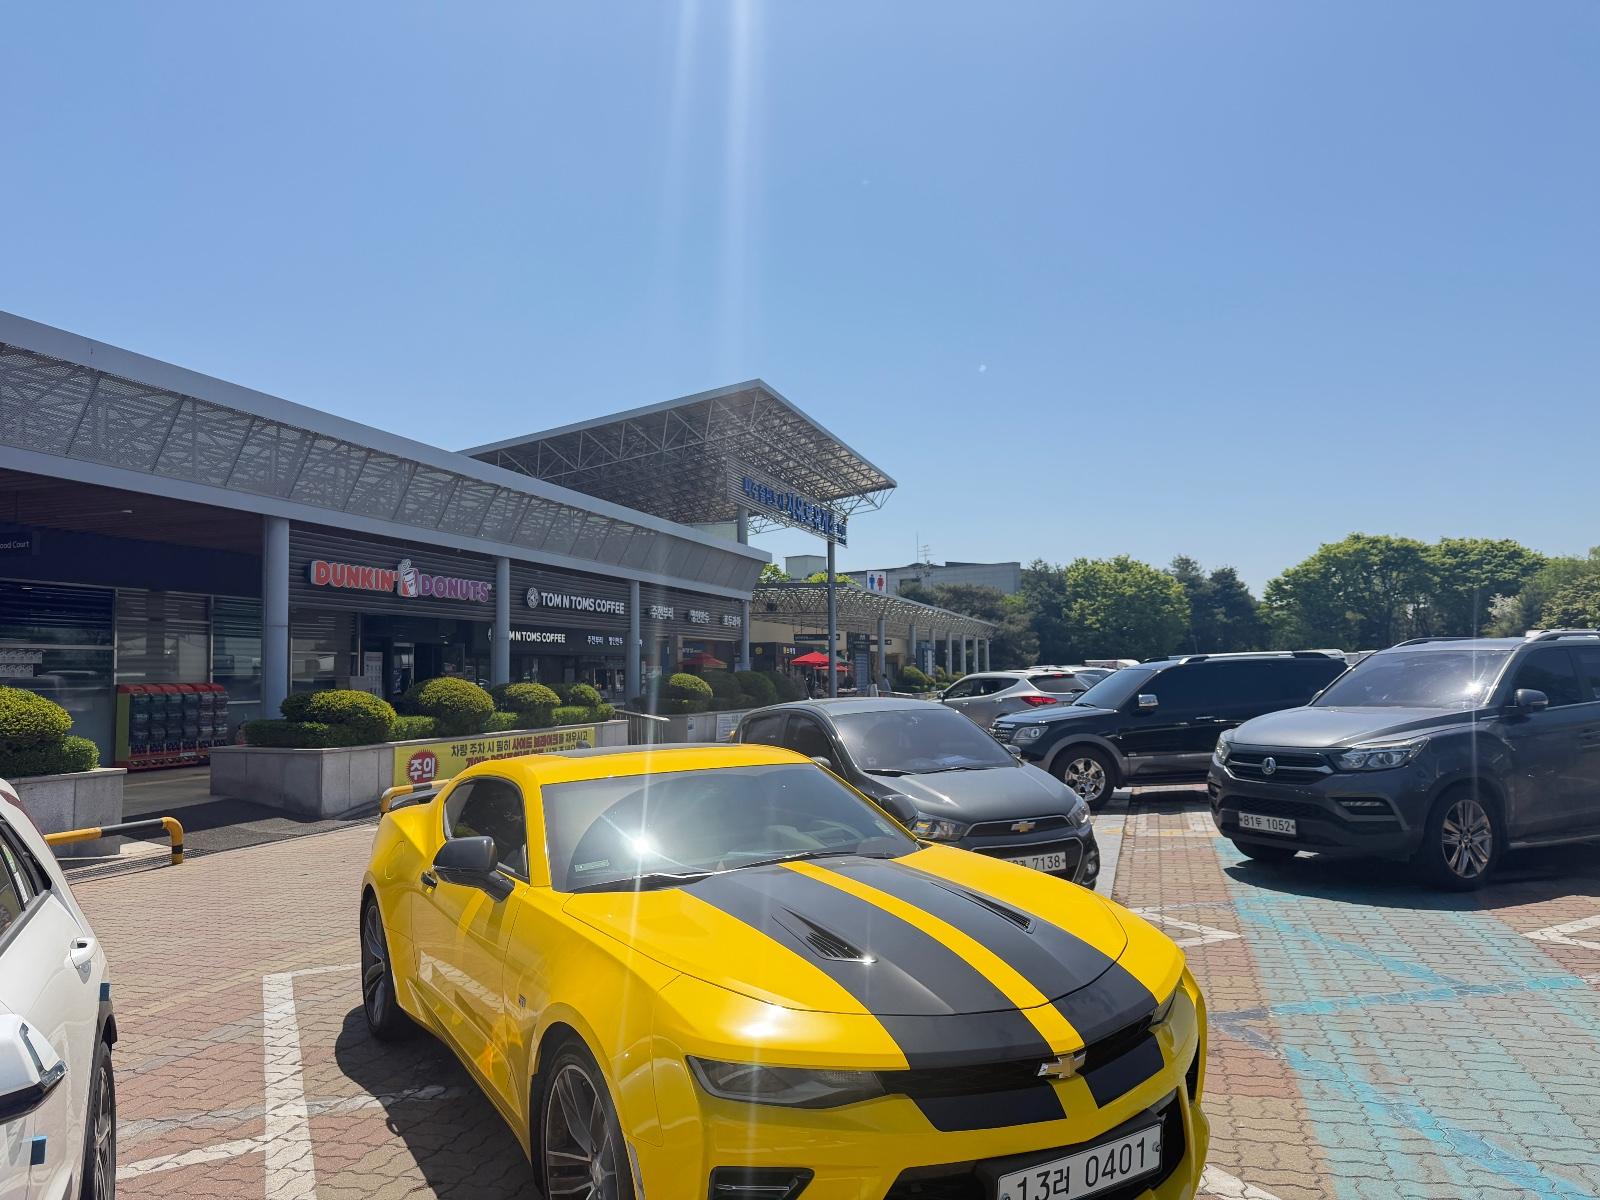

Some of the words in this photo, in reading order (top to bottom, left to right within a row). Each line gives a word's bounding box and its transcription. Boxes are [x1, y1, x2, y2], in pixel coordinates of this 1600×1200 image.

[0, 541, 11, 549] ood
[13, 540, 30, 549] Court
[419, 575, 490, 602] DONUTS
[541, 592, 562, 608] TOM
[563, 595, 570, 609] N
[571, 597, 595, 612] TOMS
[595, 600, 625, 615] COFFEE
[516, 631, 522, 641] N
[522, 631, 541, 642] TOMS
[541, 632, 566, 643] COFFEE
[450, 743, 468, 757] 차량
[470, 742, 485, 755] 주차
[487, 741, 495, 752] 시
[496, 739, 511, 752] 필히
[410, 757, 435, 780] 주의
[1266, 818, 1290, 832] 1052
[1032, 854, 1060, 870] 7138
[1017, 1166, 1070, 1200] 13러
[1085, 1137, 1146, 1188] 0401
